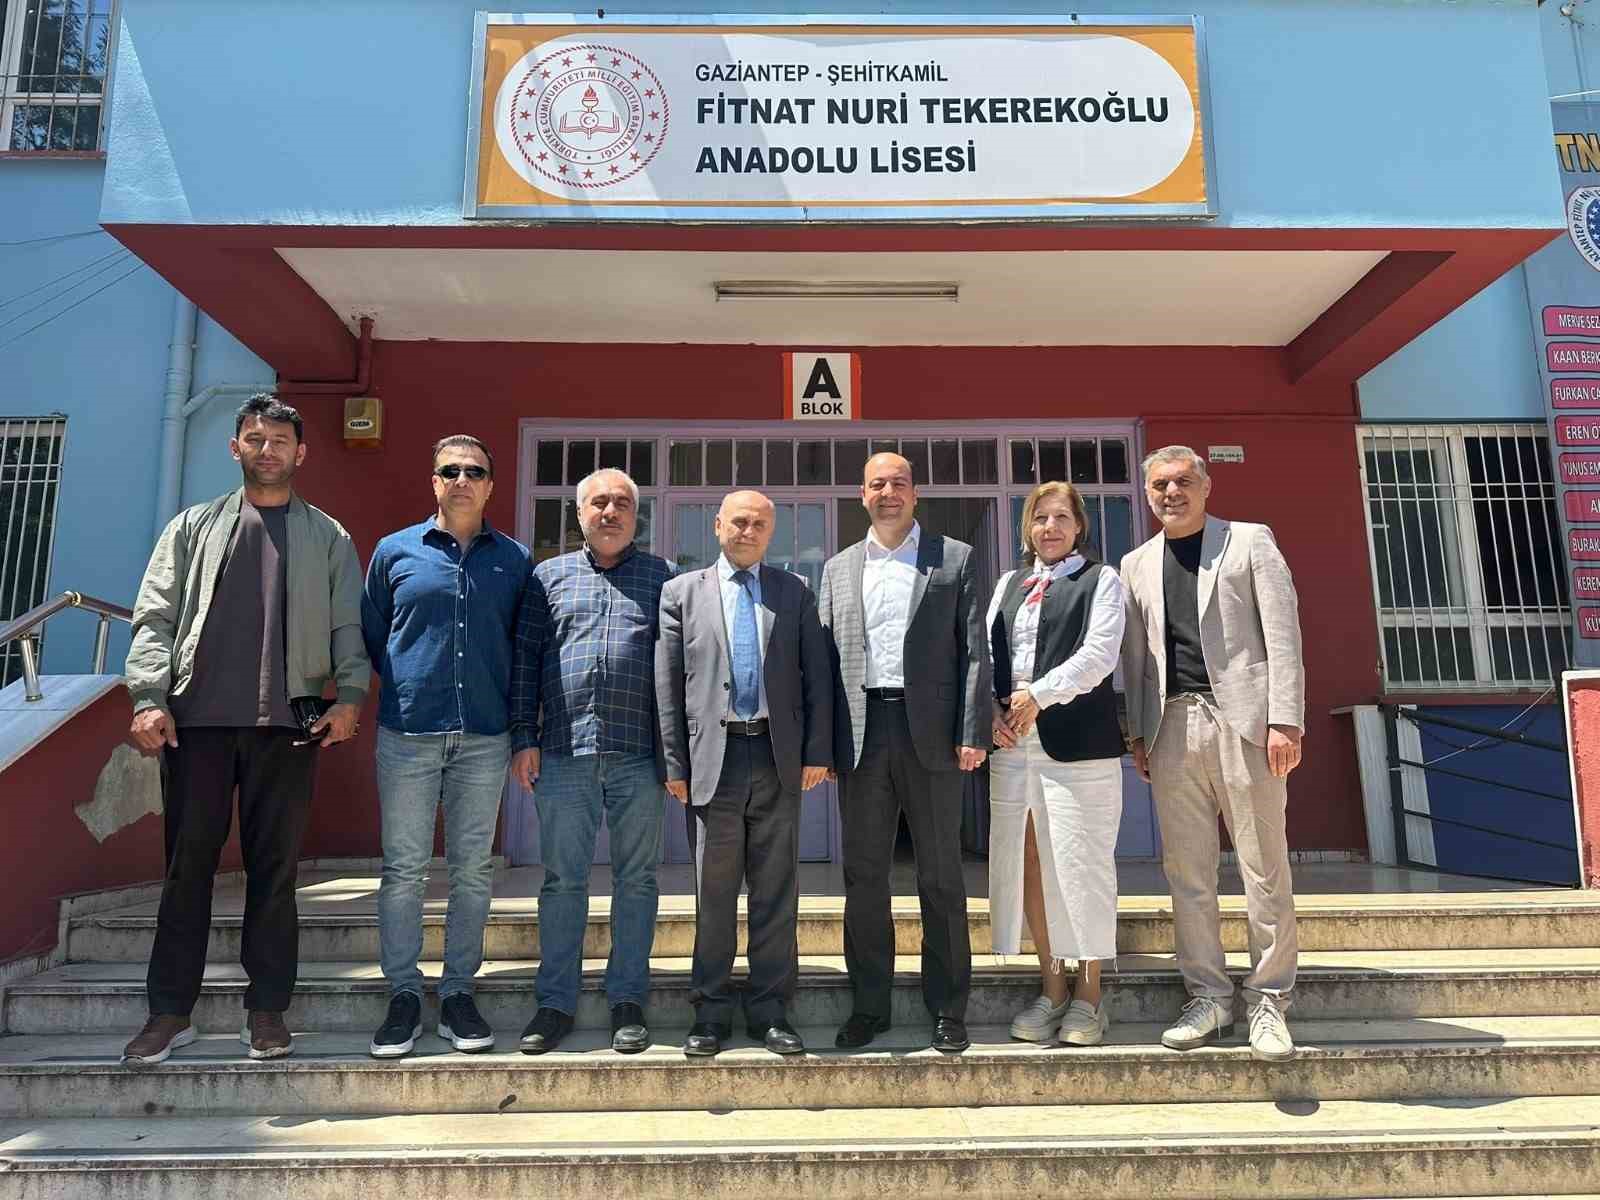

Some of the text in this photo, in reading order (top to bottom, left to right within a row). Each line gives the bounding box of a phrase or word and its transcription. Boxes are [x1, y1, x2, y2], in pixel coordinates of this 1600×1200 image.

[695, 61, 809, 83] GAZİANTEP
[827, 61, 949, 87] ŞEHİTKAMİL
[697, 91, 1169, 124] FİTNAT NURİ TEKEREKOĞLU
[695, 140, 977, 174] ANADOLU LİSESİ
[1559, 314, 1584, 328] MERVE
[1553, 351, 1580, 364] KAAN
[802, 357, 842, 399] A
[1555, 387, 1588, 400] FURKAN
[801, 402, 844, 415] BLOK
[1566, 425, 1590, 439] EREN
